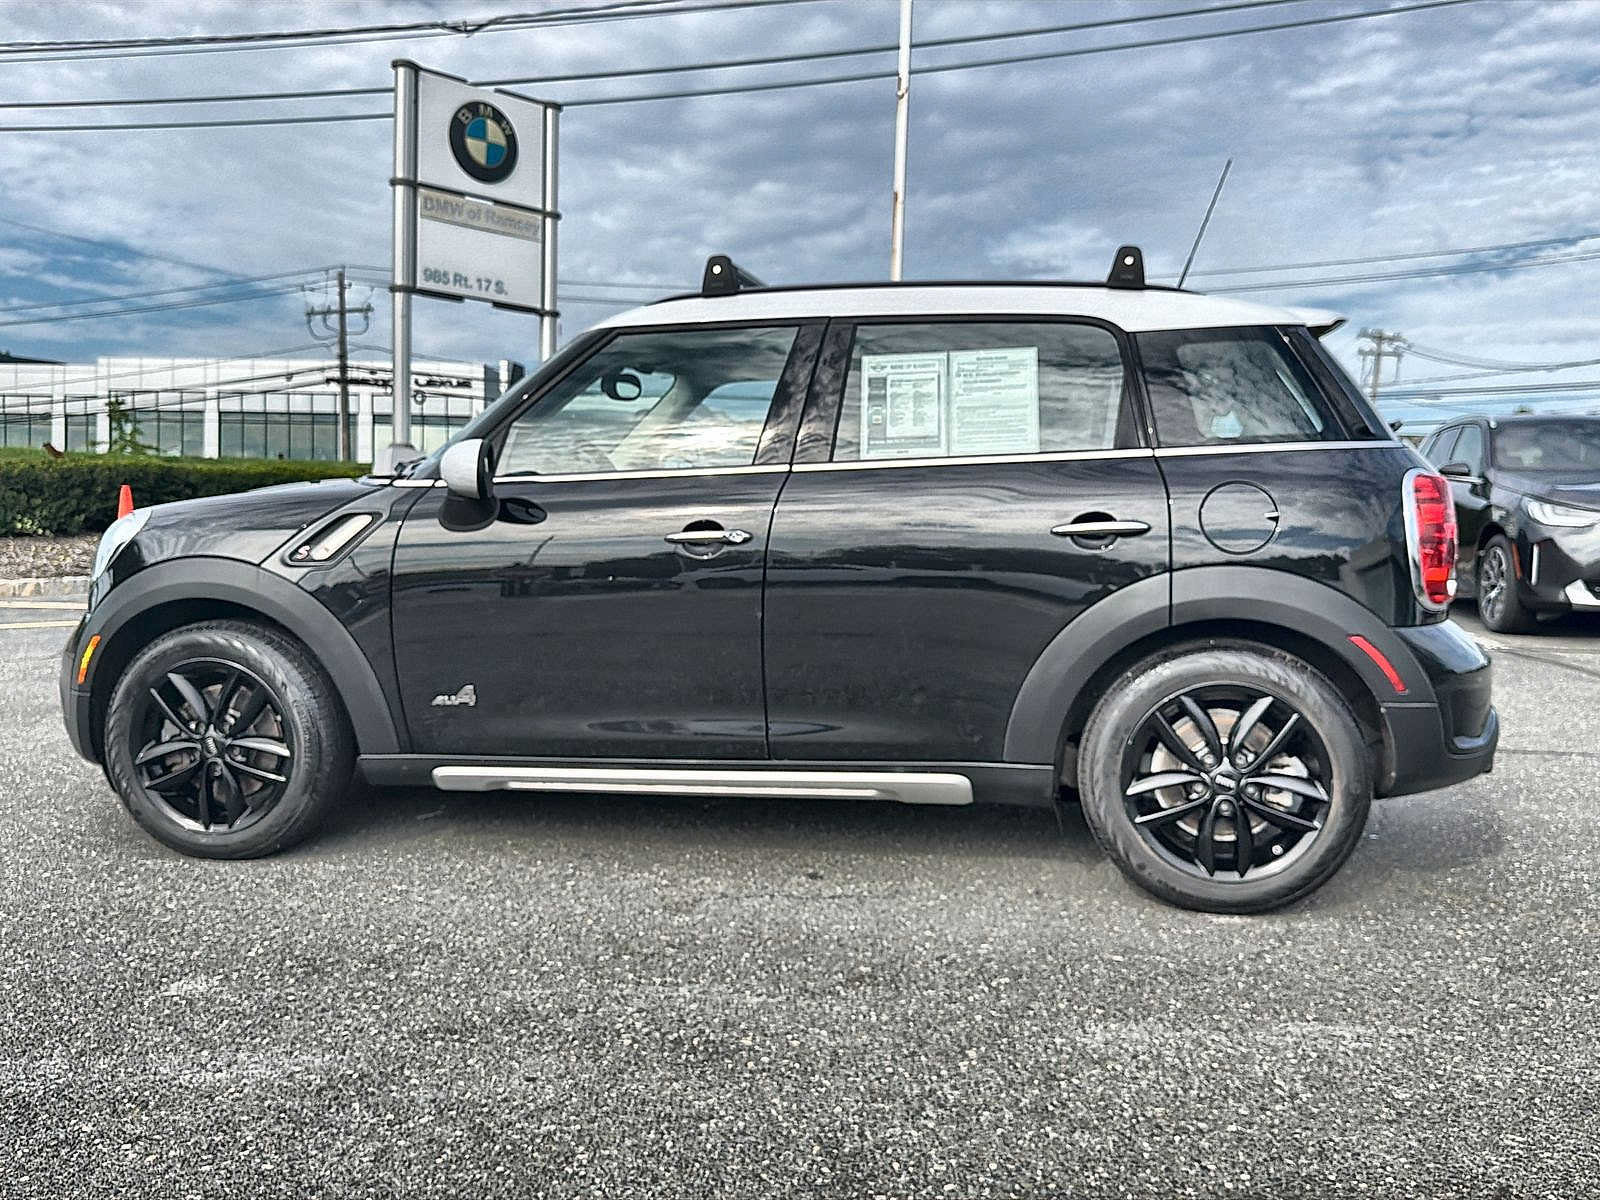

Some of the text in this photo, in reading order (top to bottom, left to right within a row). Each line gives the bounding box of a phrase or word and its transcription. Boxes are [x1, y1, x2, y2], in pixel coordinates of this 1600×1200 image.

[457, 103, 513, 136] BMW
[423, 196, 464, 216] BMW
[466, 207, 482, 221] of
[422, 267, 450, 286] 985
[476, 277, 492, 292] 17
